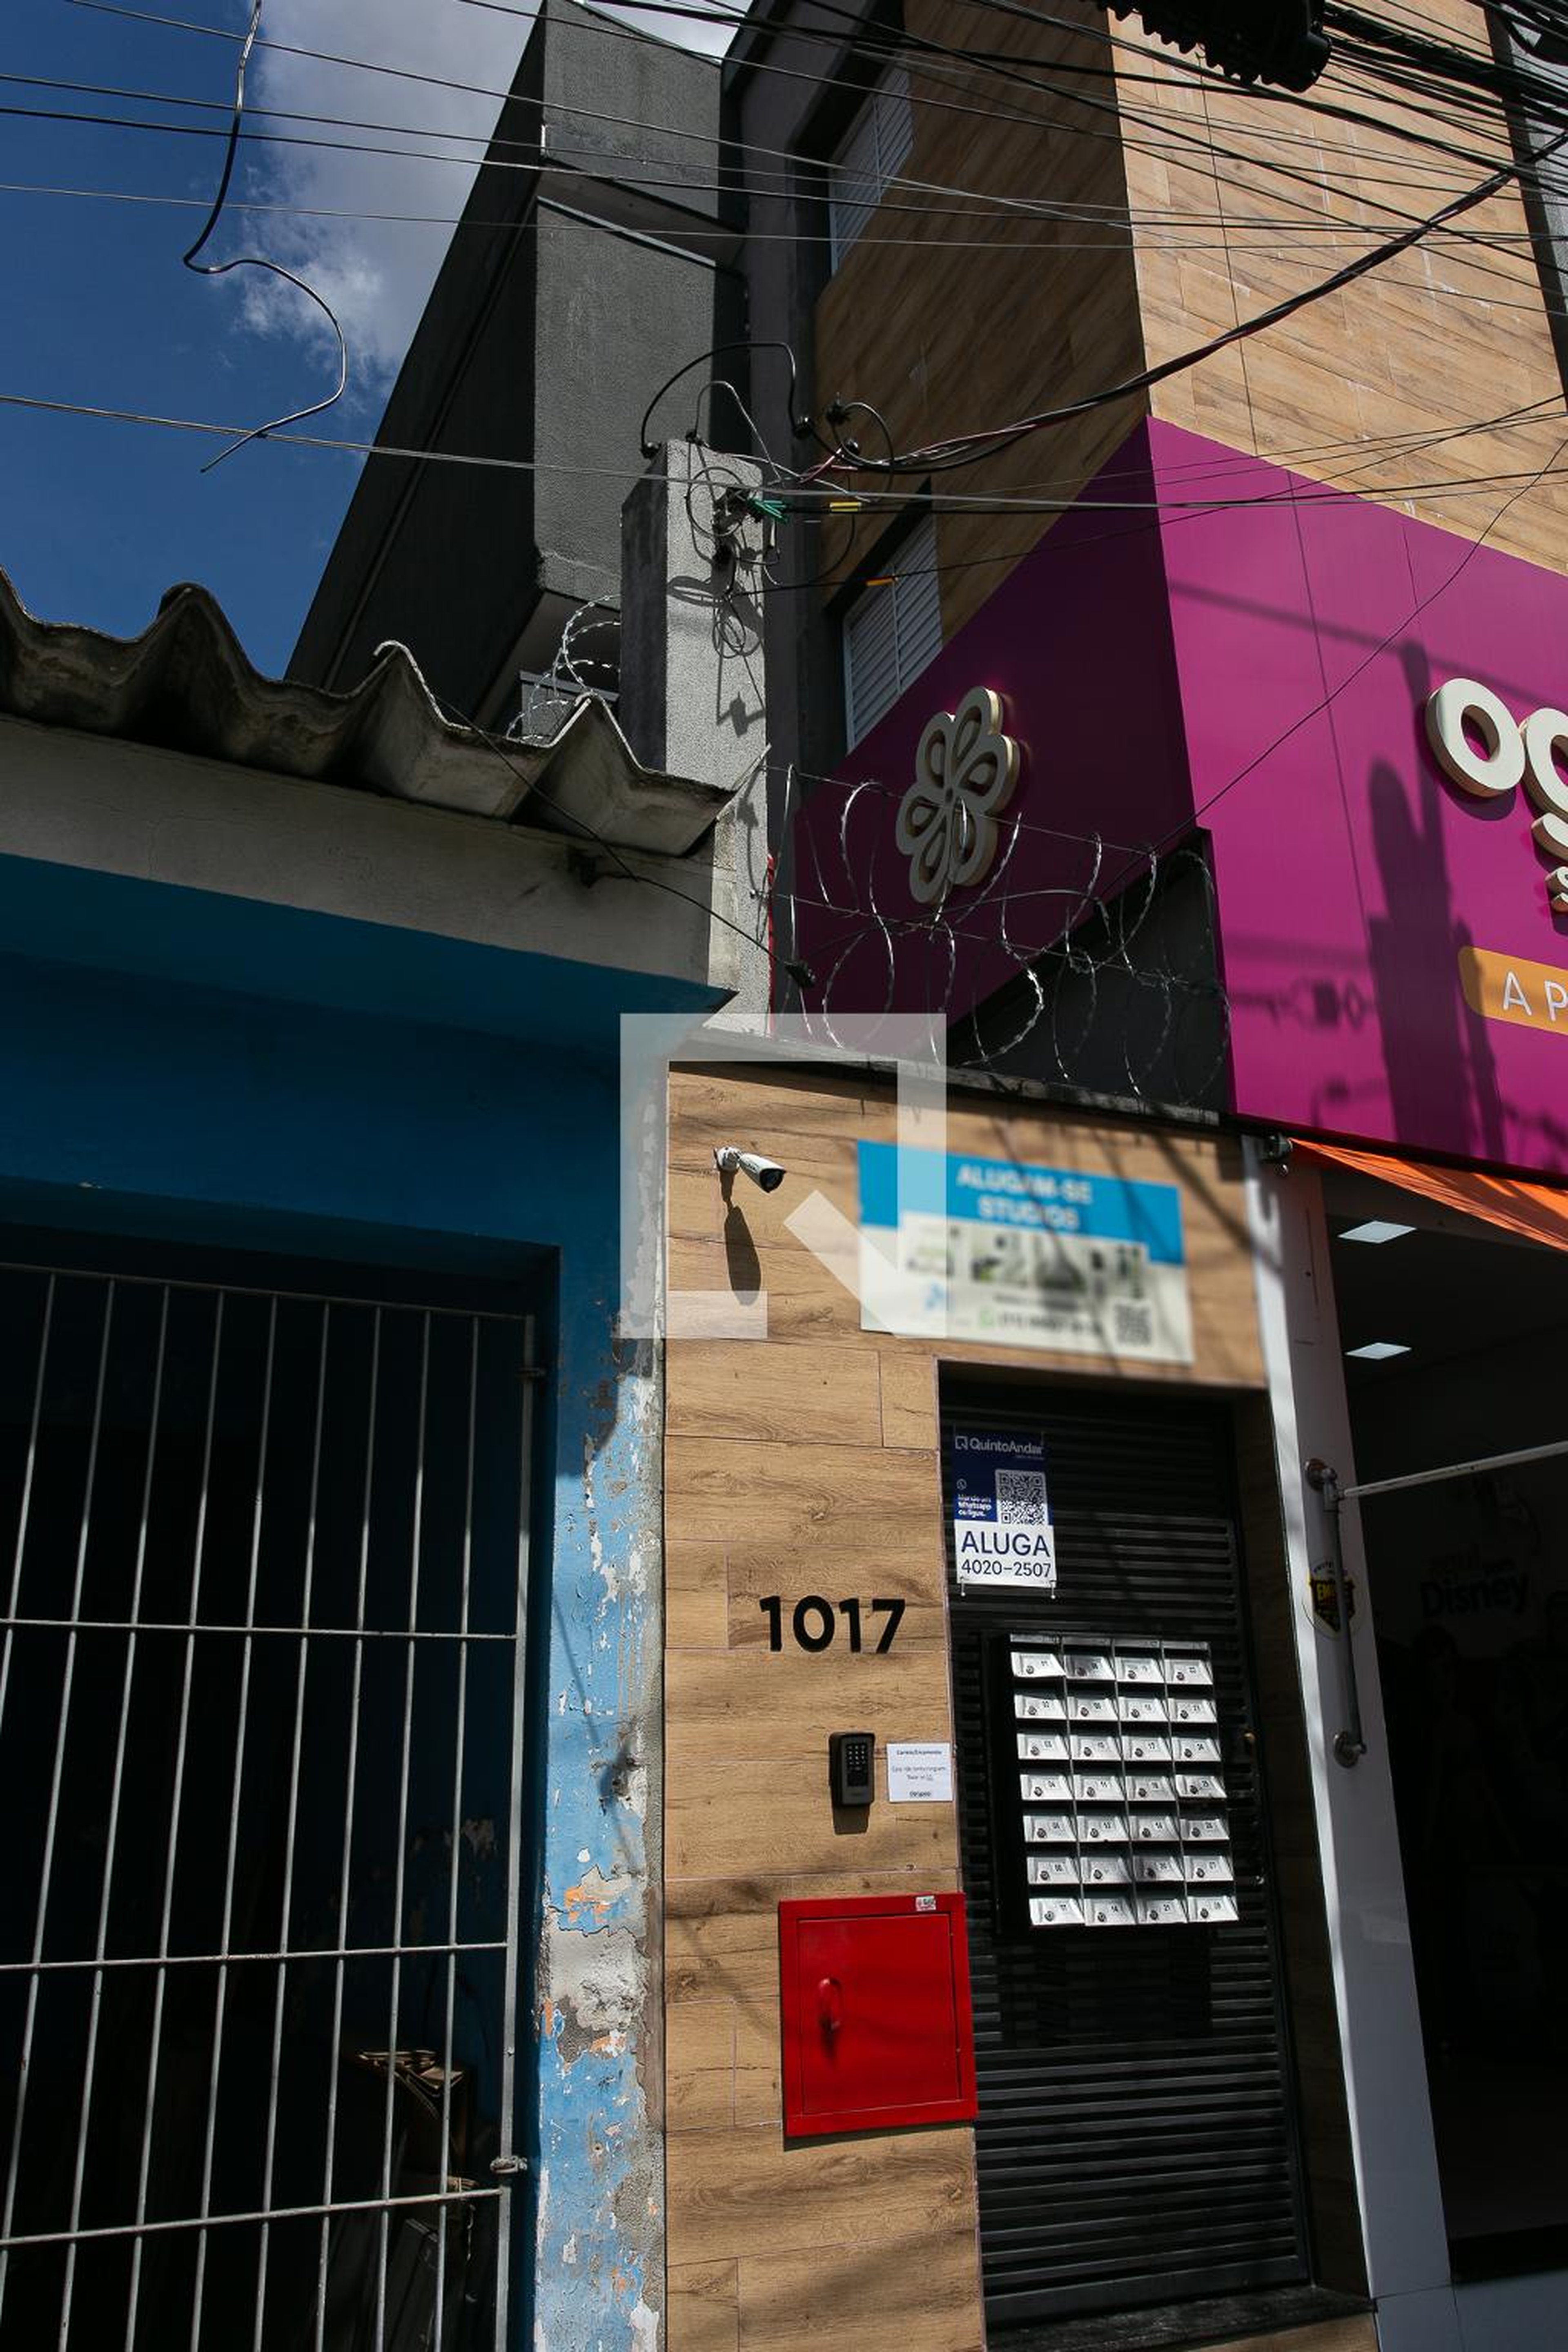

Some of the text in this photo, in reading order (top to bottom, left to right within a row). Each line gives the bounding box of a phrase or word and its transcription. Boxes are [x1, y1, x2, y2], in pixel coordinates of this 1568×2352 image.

[1503, 970, 1568, 1021] AP
[970, 1437, 1043, 1455] QuintoAndar
[961, 1530, 1051, 1557] ALUGA
[962, 1559, 1051, 1578] 4020-2507
[759, 1595, 906, 1654] 1017
